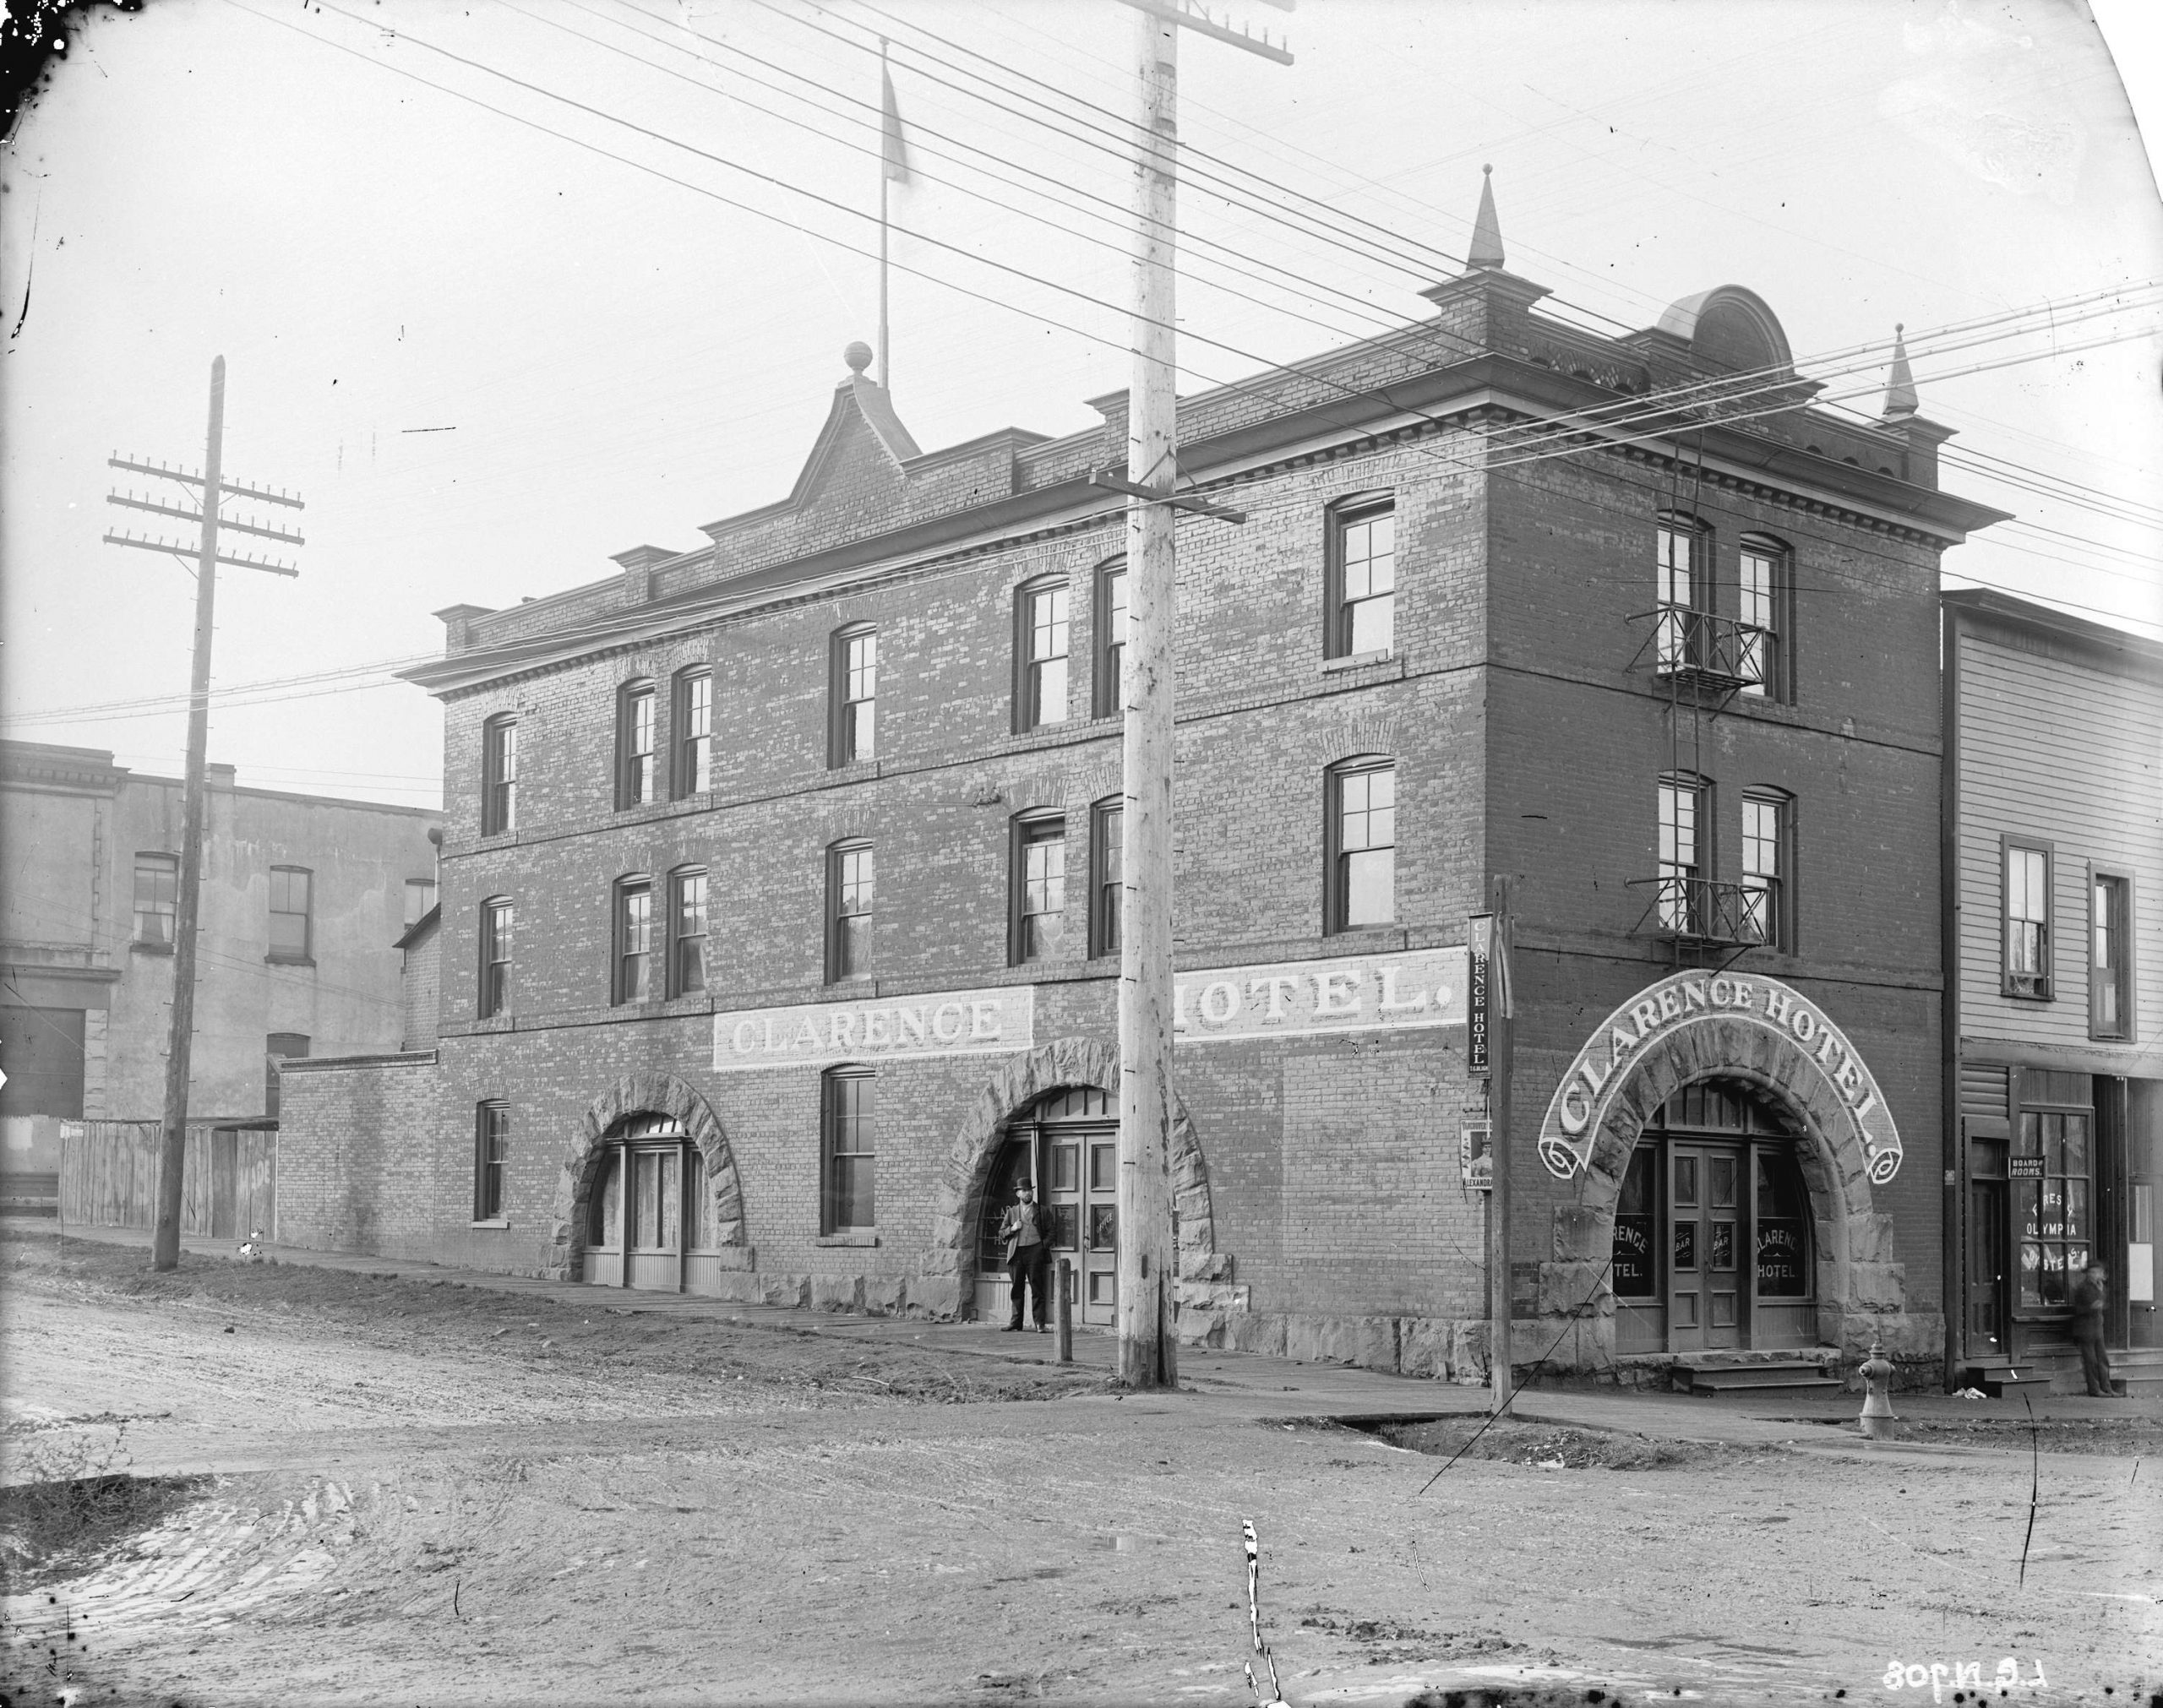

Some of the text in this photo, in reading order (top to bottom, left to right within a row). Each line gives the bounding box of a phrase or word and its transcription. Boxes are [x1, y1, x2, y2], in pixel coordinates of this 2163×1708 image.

[1474, 921, 1486, 1064] CLARENCE HOTEL
[733, 998, 1003, 1055] CLARENCE
[1559, 979, 1877, 1158] CLARENCE HOTEL.
[2013, 1159, 2038, 1167] BOARD
[2011, 1167, 2042, 1176] ROOMS.
[2026, 1222, 2077, 1236] OLYMPIA
[1613, 1225, 1649, 1254] RENCE
[1675, 1237, 1691, 1252] BAR
[1714, 1236, 1729, 1250] BAR
[1757, 1229, 1800, 1254] LARENC
[1614, 1263, 1643, 1277] TEL.
